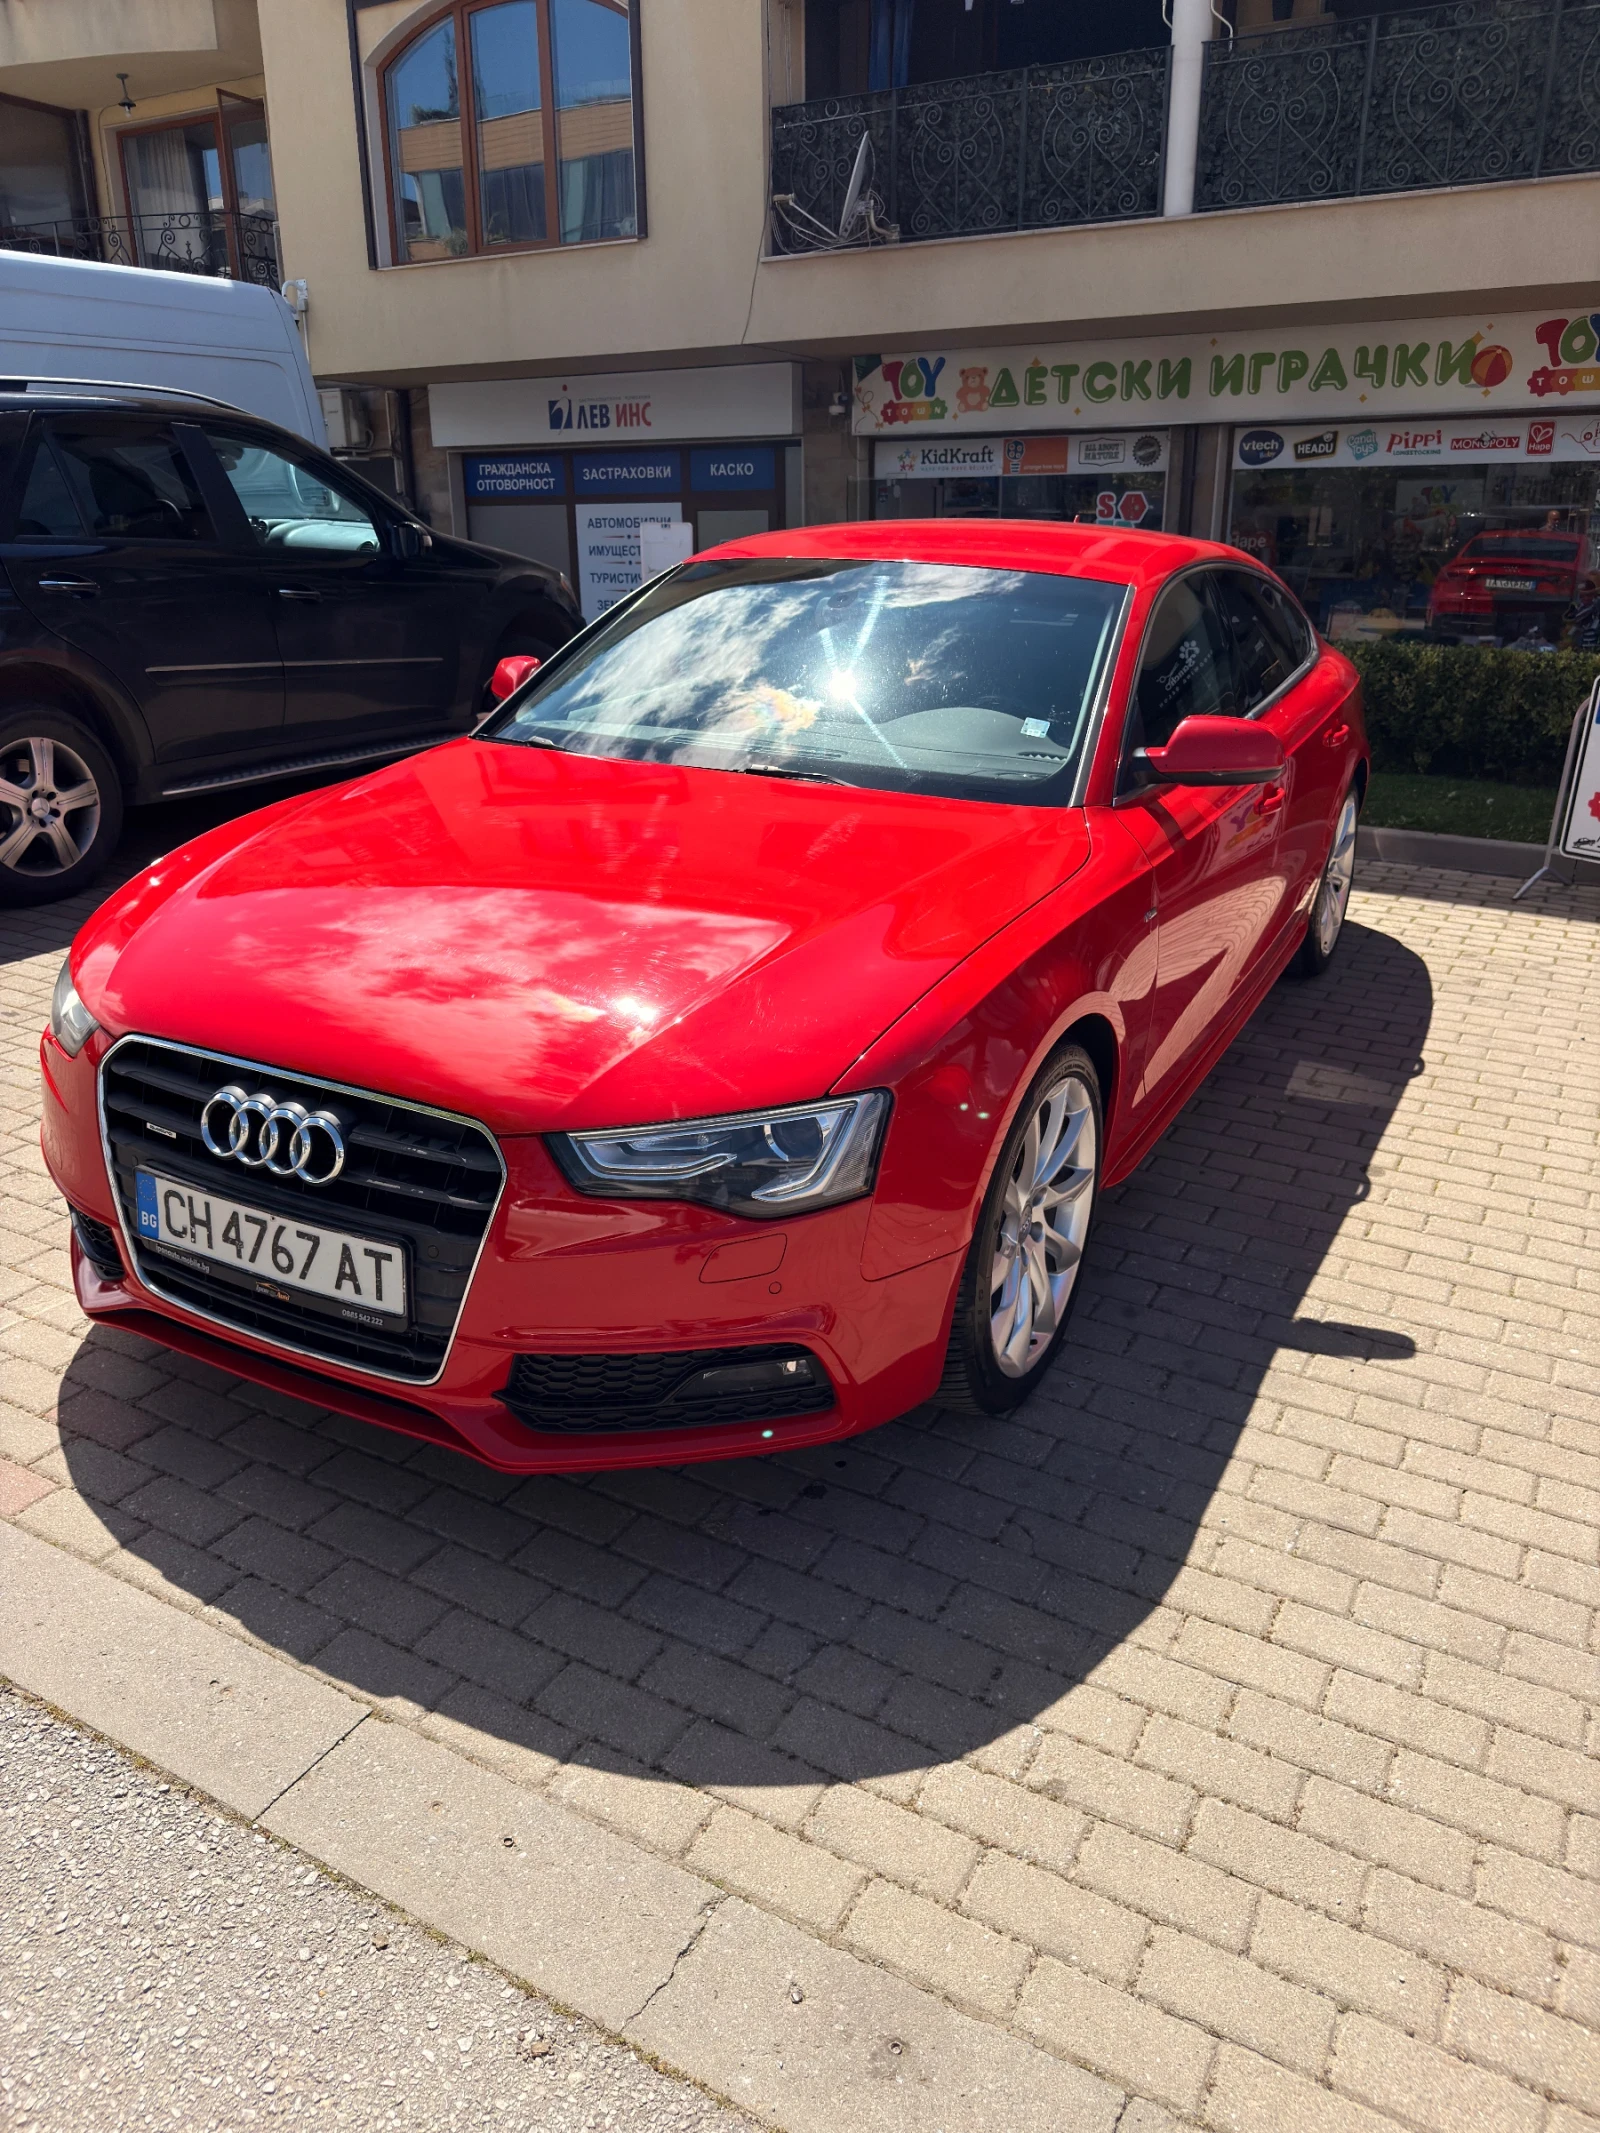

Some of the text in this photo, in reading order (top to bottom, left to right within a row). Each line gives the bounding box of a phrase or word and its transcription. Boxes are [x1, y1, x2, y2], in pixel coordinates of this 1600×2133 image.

[883, 356, 946, 401] TOY
[988, 339, 1476, 407] ДЕТСКИ ИГРАЧКИ
[1537, 375, 1595, 386] TOW
[577, 402, 652, 429] ЛЕВ ИНС
[886, 405, 941, 416] TOWN
[1243, 439, 1279, 450] vtech
[1348, 431, 1376, 446] Canal
[1451, 438, 1519, 449] MONOPOLY
[1297, 443, 1334, 454] HEADU
[1351, 443, 1375, 456] Toys
[1528, 443, 1551, 451] Hape
[921, 446, 994, 464] KidKraft
[479, 463, 551, 476] ГРАЖДАНСКА
[582, 466, 672, 480] ЗАСТРАХОВКИ
[710, 463, 754, 476] КАСКО
[477, 478, 555, 491] ОТГОВОРНОСТ
[1421, 484, 1457, 504] TOY
[589, 545, 641, 557] ИМУЩЕСТ
[141, 1211, 157, 1228] BG
[163, 1189, 393, 1301] CH 4767 AT
[359, 1313, 370, 1322] 542
[371, 1316, 383, 1325] 222
